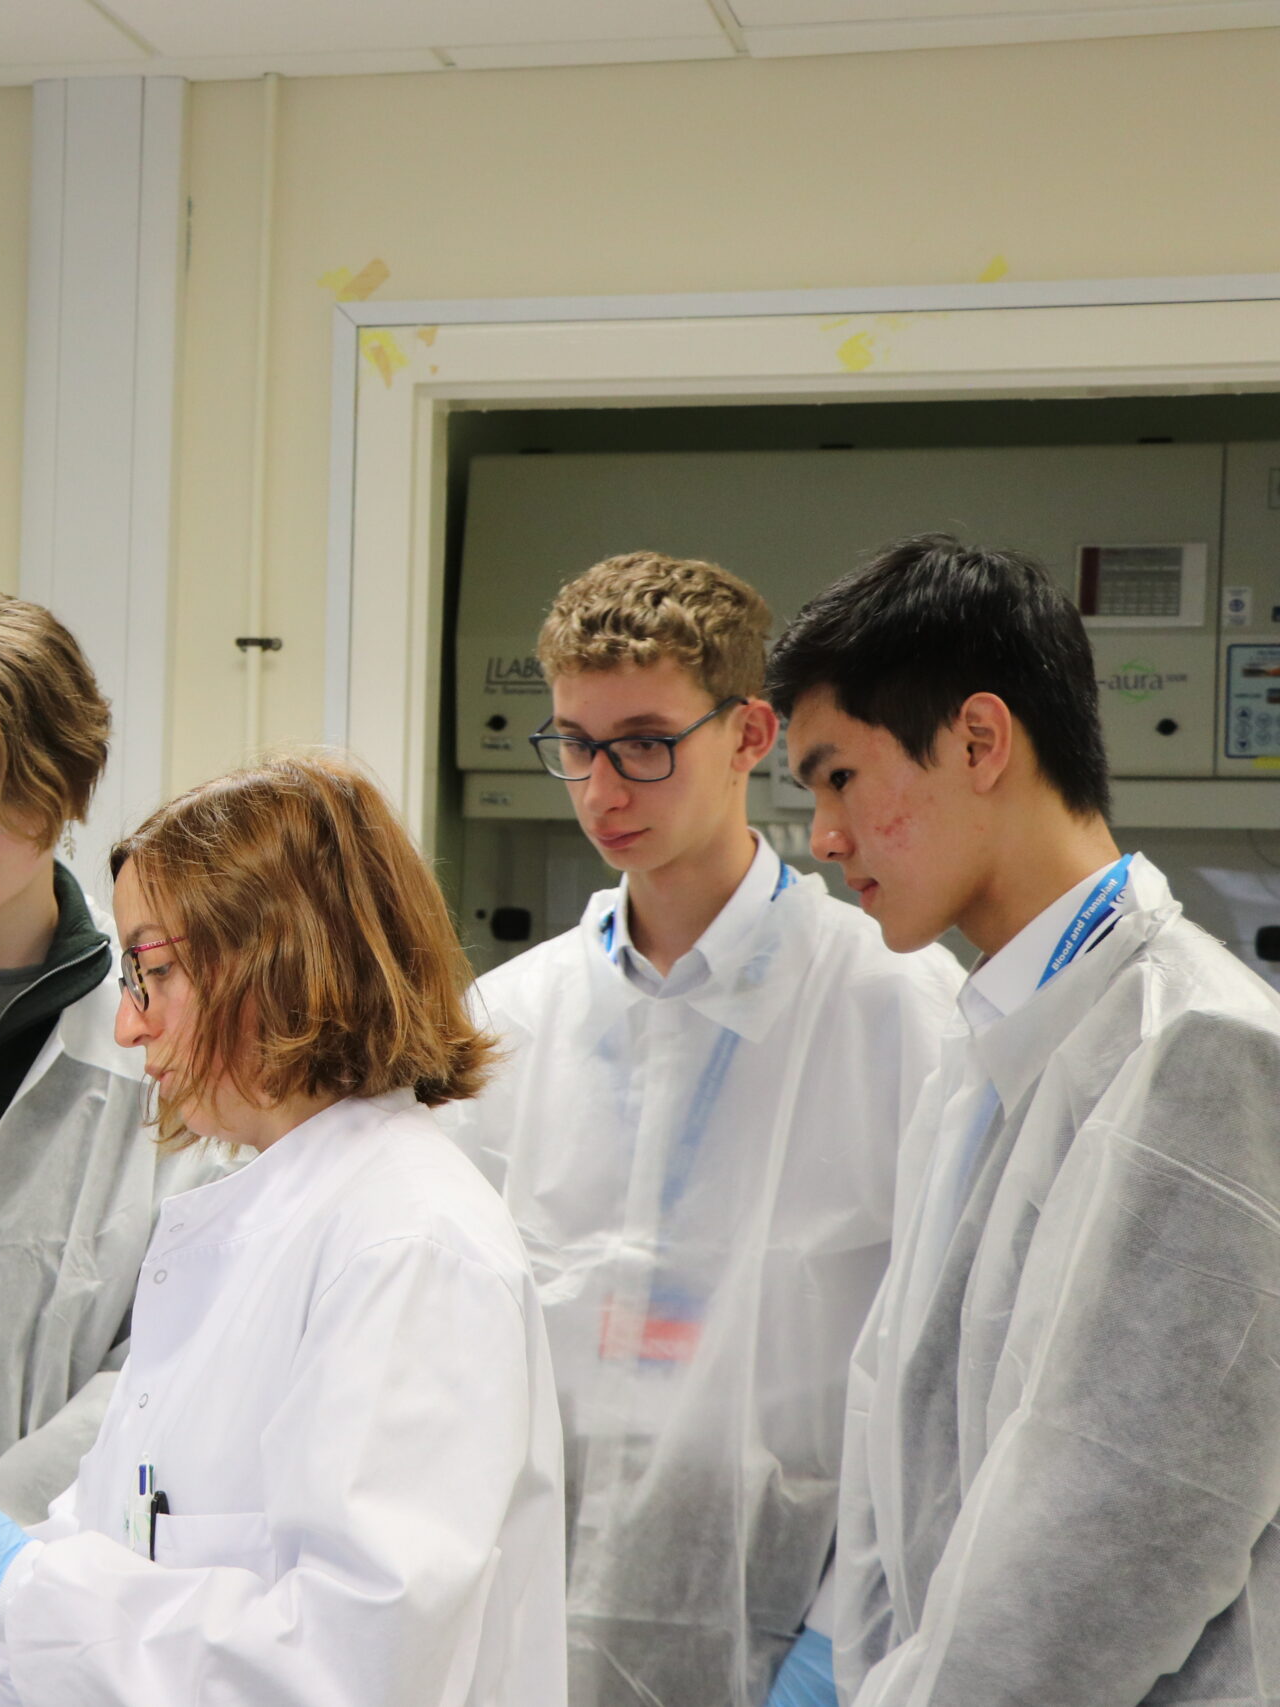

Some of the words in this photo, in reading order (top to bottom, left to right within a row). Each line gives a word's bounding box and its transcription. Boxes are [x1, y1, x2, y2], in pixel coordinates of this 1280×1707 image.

[1051, 939, 1074, 971] Blood
[1070, 918, 1086, 942] and
[1081, 878, 1119, 920] Transplant
